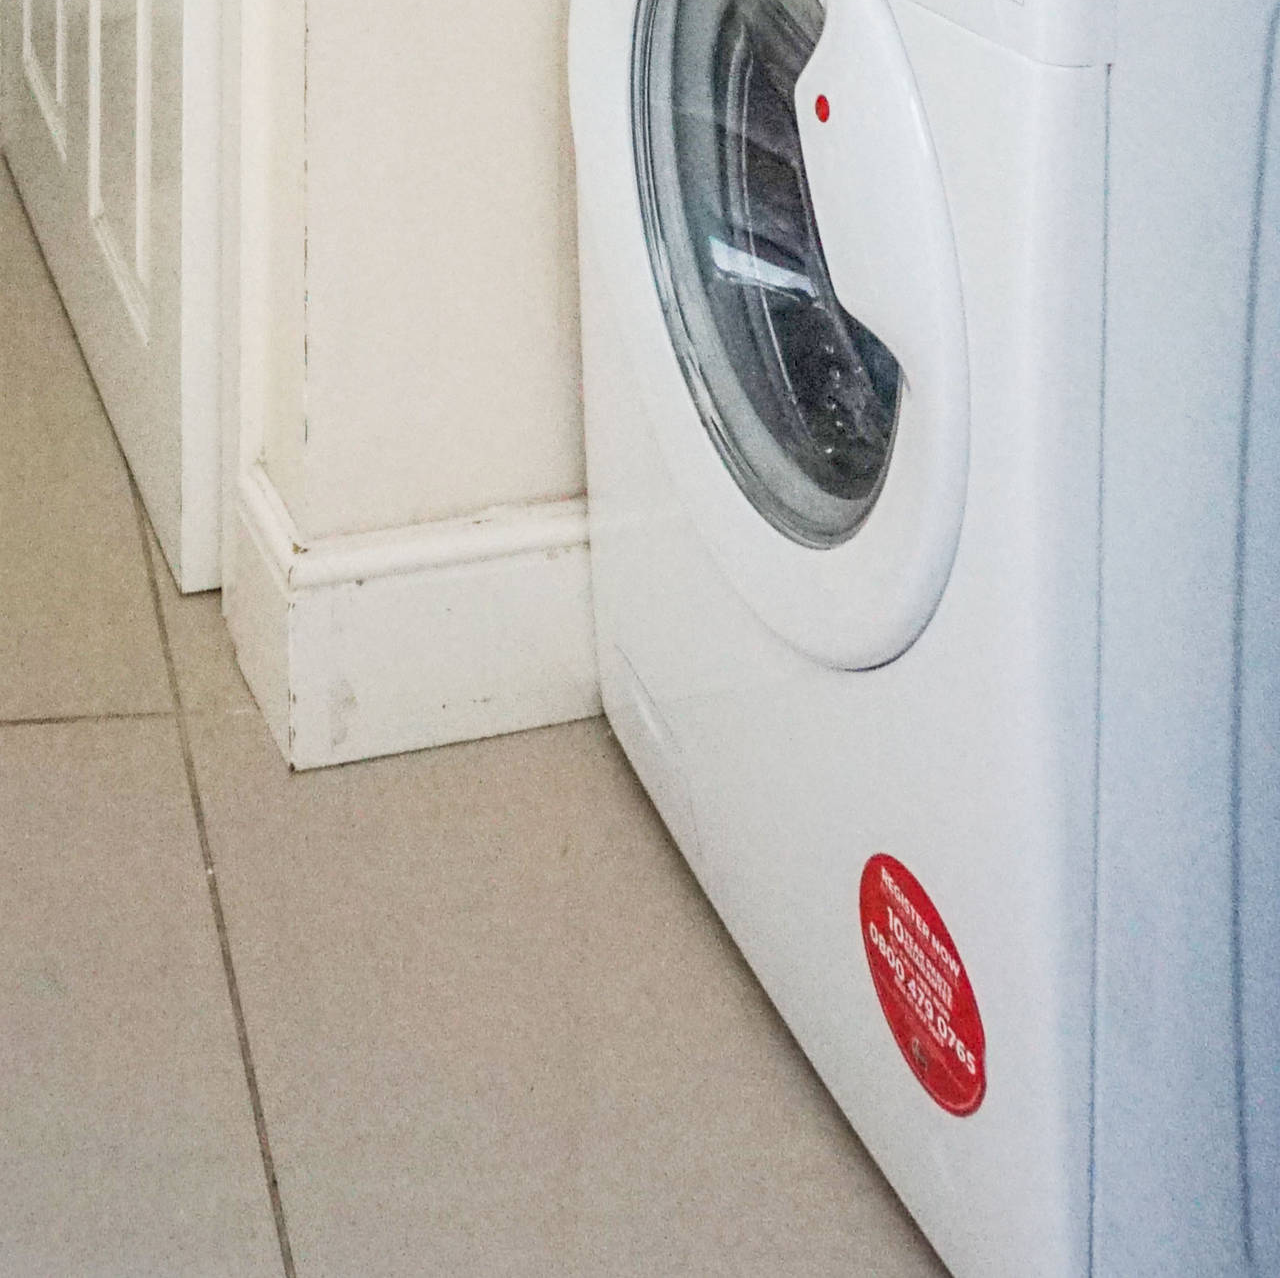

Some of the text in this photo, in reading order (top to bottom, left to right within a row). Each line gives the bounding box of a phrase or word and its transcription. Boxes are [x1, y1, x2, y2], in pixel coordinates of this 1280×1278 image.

[881, 865, 930, 940] REGISTER
[931, 933, 960, 979] NOW
[886, 905, 904, 944] 10
[869, 921, 906, 981] 0800
[937, 1015, 976, 1075] 0765
